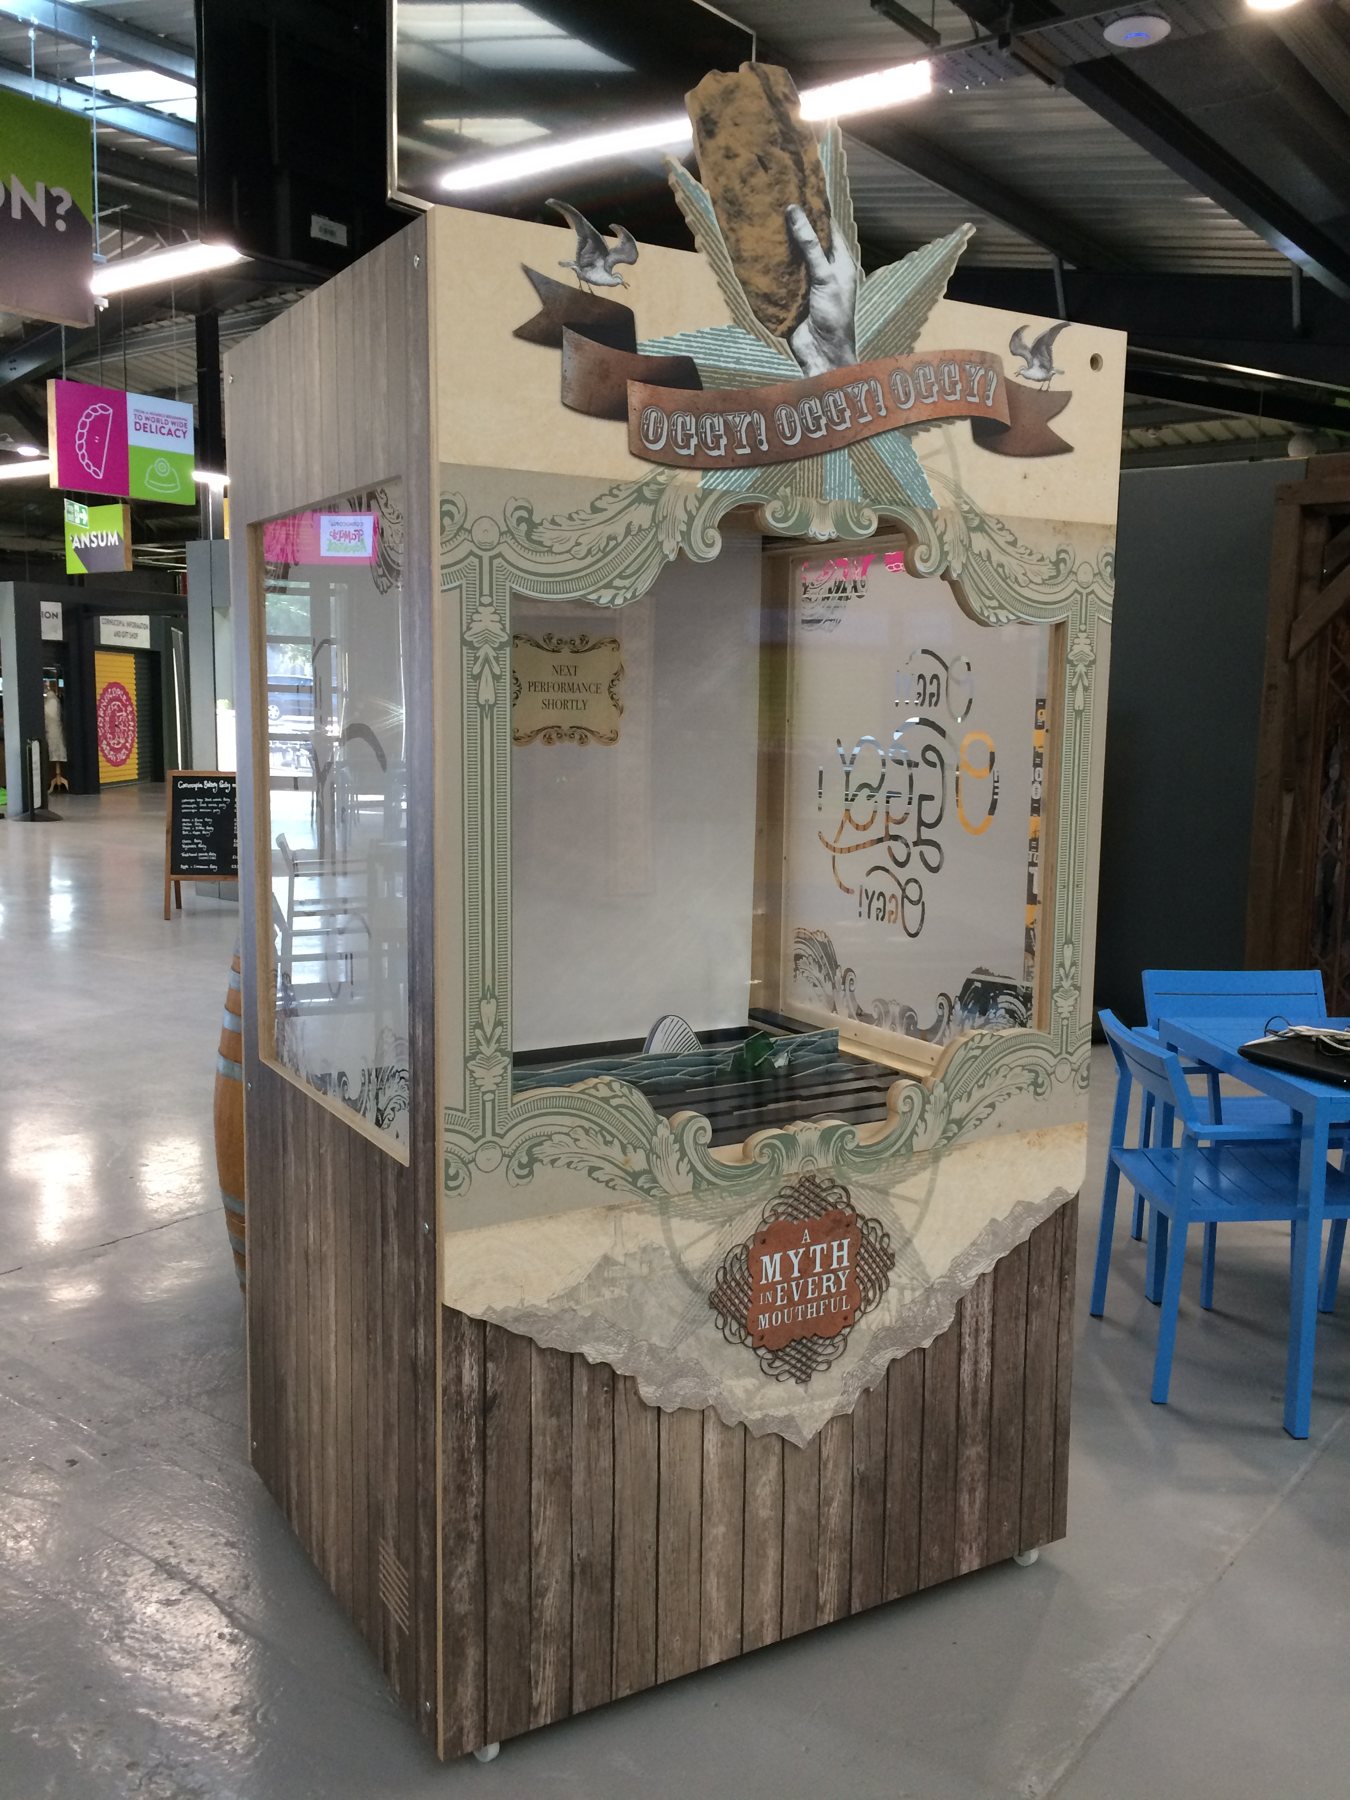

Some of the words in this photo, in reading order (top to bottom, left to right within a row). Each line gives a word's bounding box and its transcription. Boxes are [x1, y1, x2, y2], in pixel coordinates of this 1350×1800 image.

[0, 174, 73, 232] N?
[640, 405, 769, 456] OGGY!
[775, 378, 888, 446] OGGY!
[889, 361, 998, 411] OGGY!
[134, 421, 188, 439] DELICACY
[552, 664, 578, 677] NEXT
[527, 680, 603, 695] PERFORMANCE
[541, 698, 588, 711] SHORTLY
[801, 1228, 811, 1244] A
[759, 1238, 851, 1285] MYTH
[759, 1290, 773, 1305] IN
[775, 1269, 850, 1306] EVERY
[758, 1294, 851, 1330] MOUTHFUL
